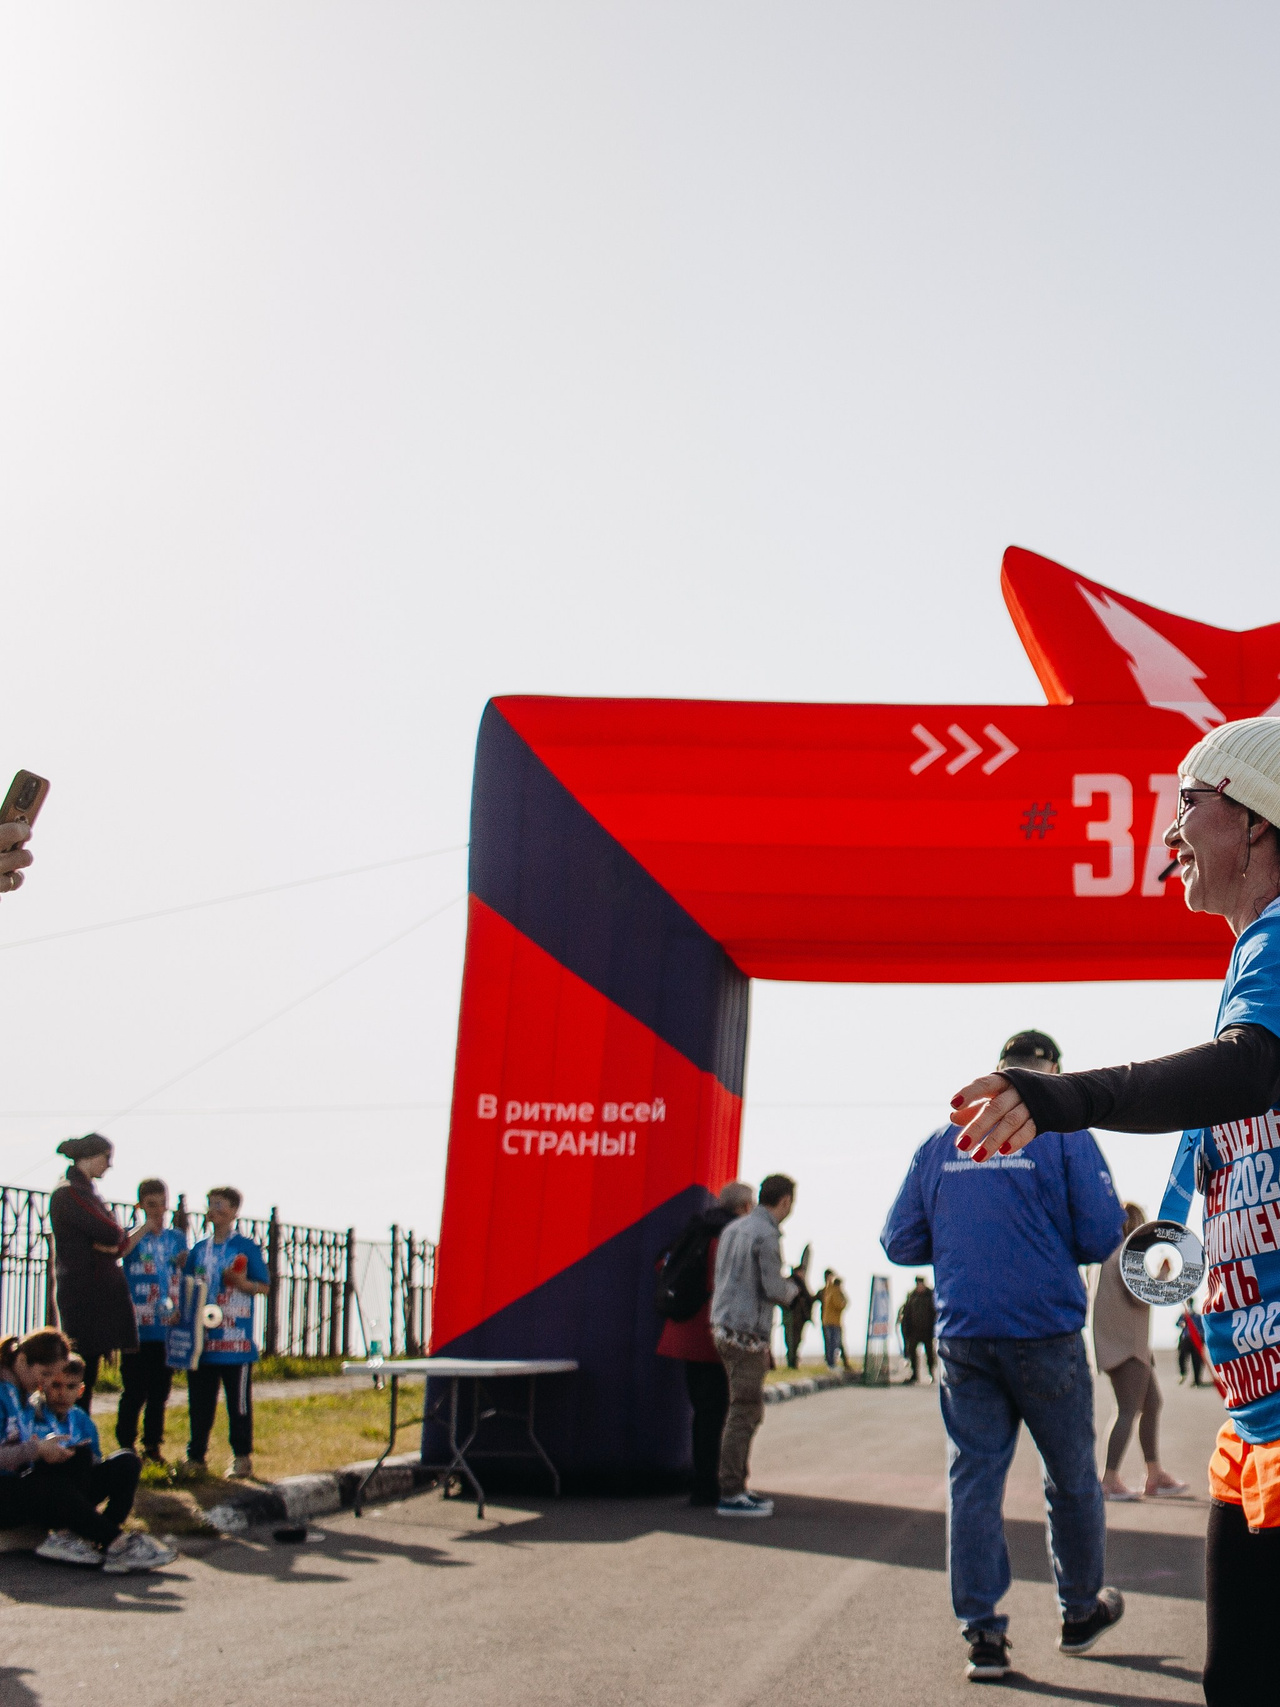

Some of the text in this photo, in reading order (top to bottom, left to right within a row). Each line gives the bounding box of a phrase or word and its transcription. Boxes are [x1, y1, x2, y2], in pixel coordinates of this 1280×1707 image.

[478, 1093, 666, 1124] В ритме всей
[502, 1128, 637, 1156] СТРАНЫ!
